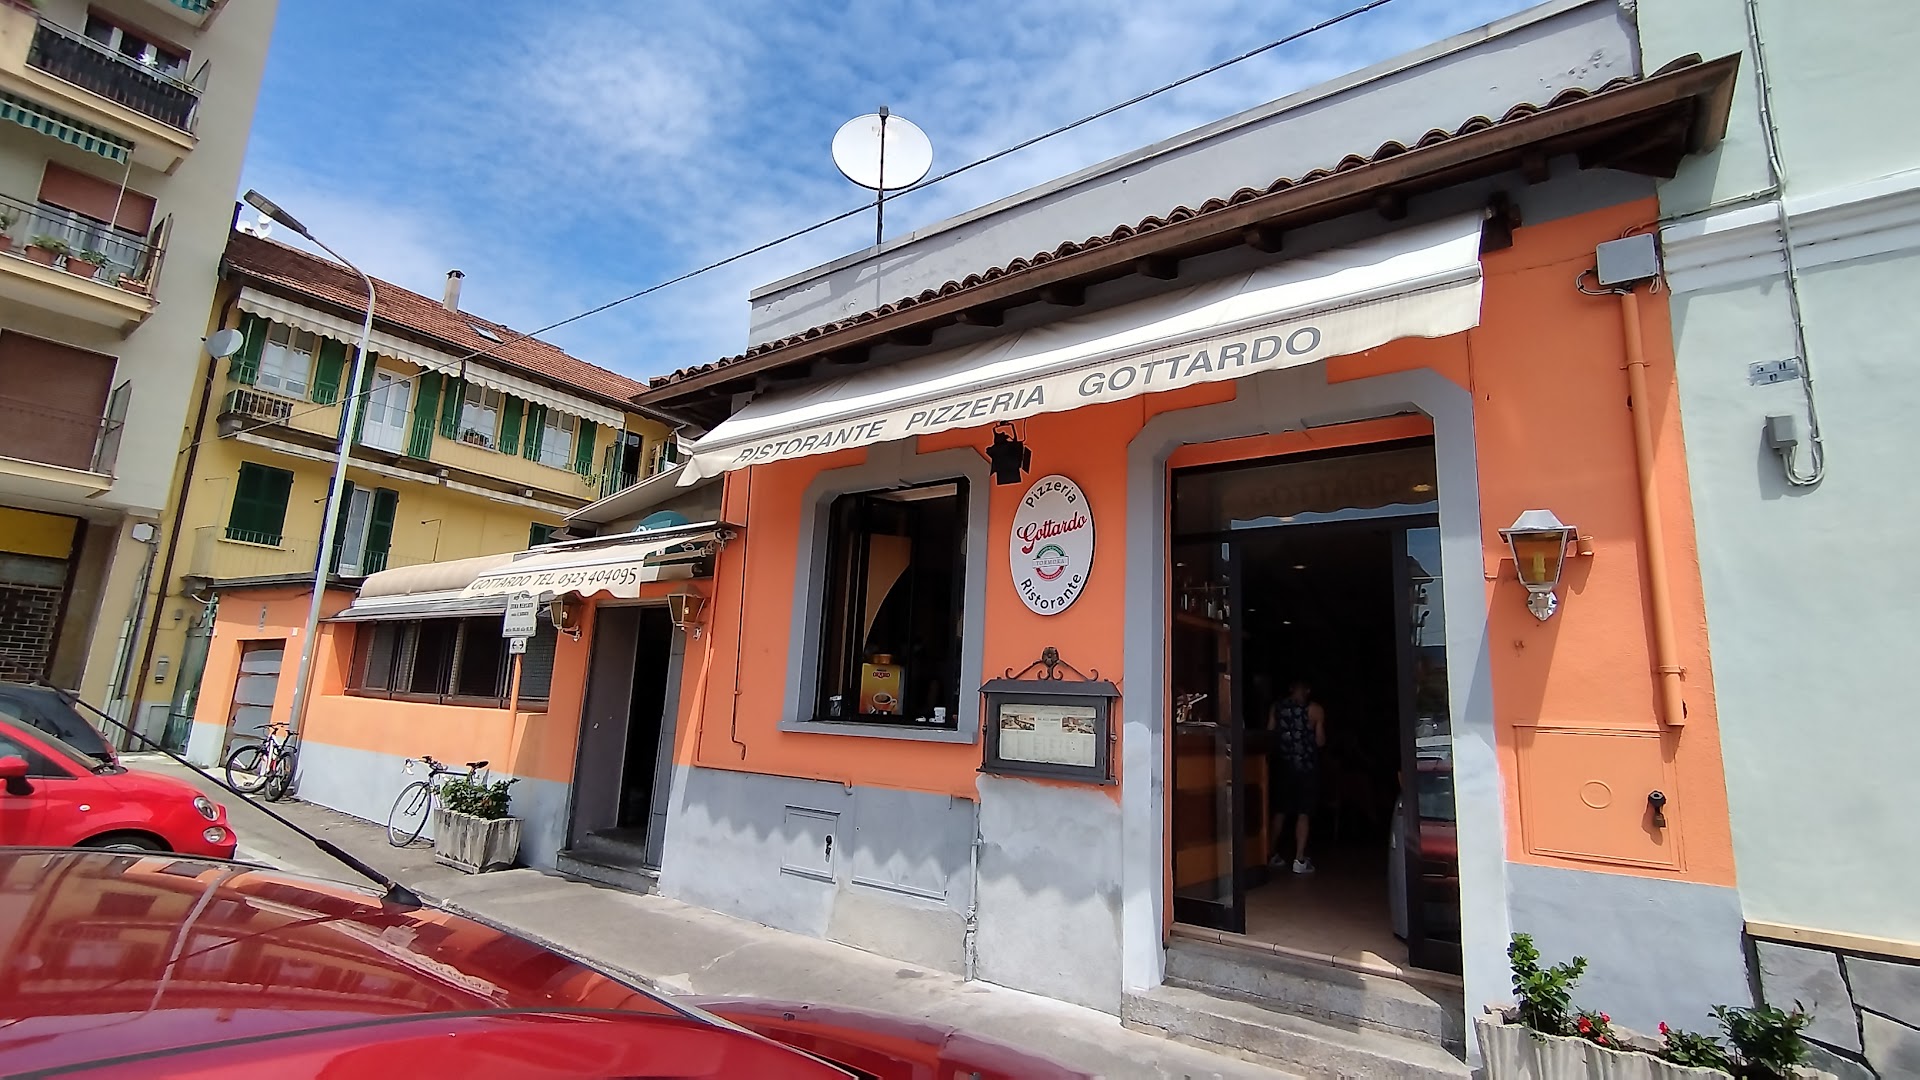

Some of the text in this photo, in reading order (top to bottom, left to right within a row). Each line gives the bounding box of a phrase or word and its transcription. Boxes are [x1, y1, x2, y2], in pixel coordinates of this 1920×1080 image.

[732, 326, 1321, 463] RISTORANTE PIZZERIA GOTTARDO
[1025, 481, 1076, 507] Pizzeria
[1016, 511, 1087, 554] Gottardo
[471, 574, 532, 590] GOTTARDO
[557, 572, 587, 588] 0323
[587, 567, 638, 586] 404095
[1020, 574, 1082, 609] Ristorante
